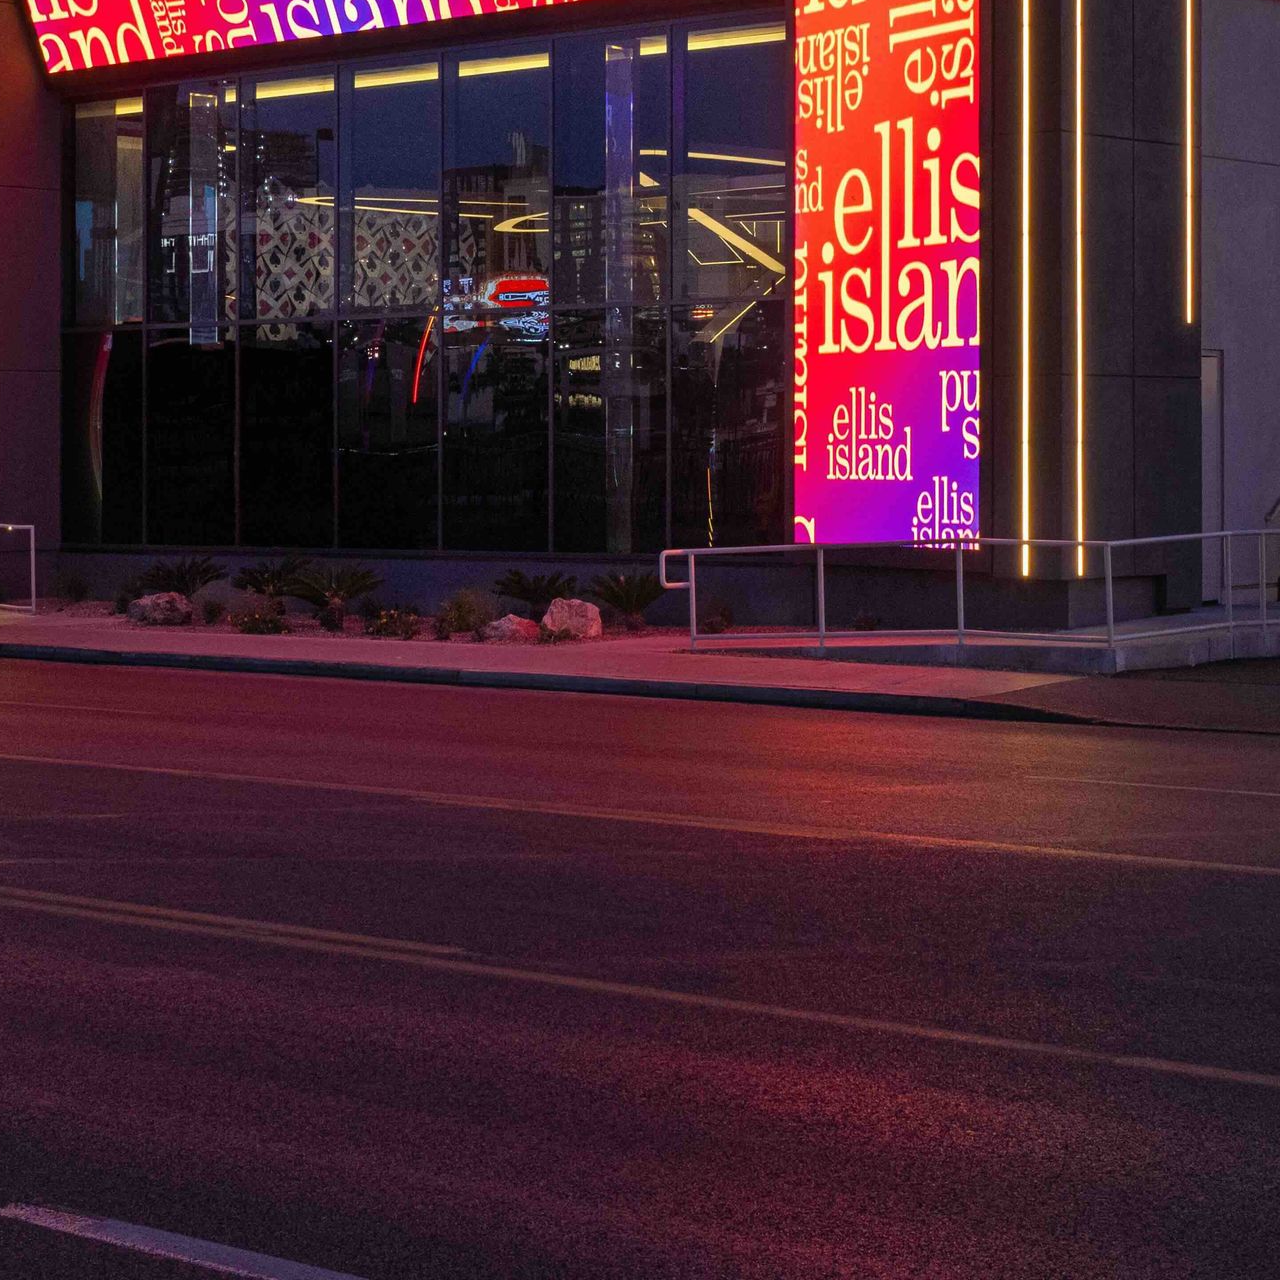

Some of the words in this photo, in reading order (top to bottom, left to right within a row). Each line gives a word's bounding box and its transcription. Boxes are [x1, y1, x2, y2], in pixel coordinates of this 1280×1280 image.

[798, 68, 864, 134] ellis
[834, 116, 980, 255] ellis
[833, 386, 894, 441] ellis
[826, 427, 913, 481] island
[916, 475, 975, 525] ellis
